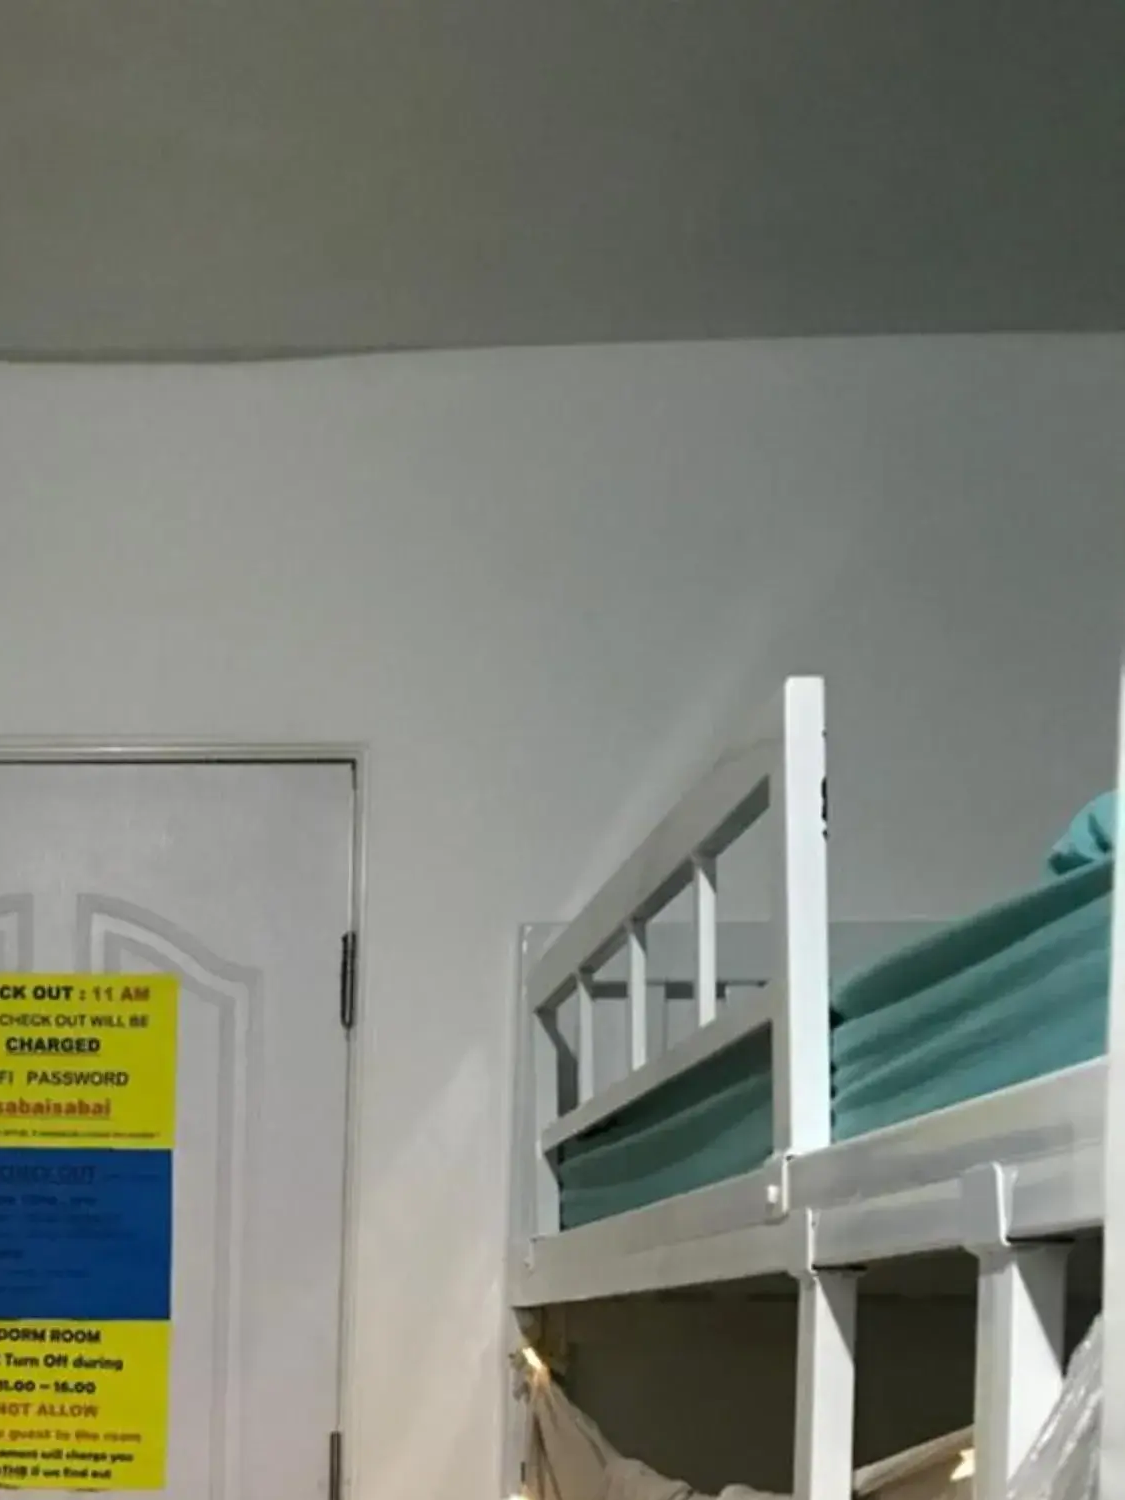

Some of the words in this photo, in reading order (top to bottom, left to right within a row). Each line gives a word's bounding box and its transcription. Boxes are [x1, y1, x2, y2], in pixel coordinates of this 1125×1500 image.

[32, 985, 73, 1001] OUT
[92, 988, 114, 1002] 11
[120, 987, 150, 1002] AM
[55, 1014, 86, 1028] OUT
[90, 1015, 124, 1029] WILL
[128, 1015, 149, 1029] BE
[5, 1036, 101, 1055] CHARGED
[26, 1070, 129, 1087] PASSWORD
[49, 1329, 102, 1344] ROOM
[4, 1353, 40, 1367] Turn
[43, 1353, 68, 1368] Off
[72, 1354, 124, 1371] during
[54, 1381, 97, 1395] 16.00
[36, 1403, 100, 1419] ALLOW
[8, 1428, 52, 1444] guest
[74, 1429, 101, 1442] the
[103, 1432, 142, 1444] room
[41, 1448, 64, 1461] will
[66, 1449, 107, 1463] charge
[109, 1453, 134, 1463] you
[62, 1467, 88, 1479] find
[90, 1468, 112, 1480] out
